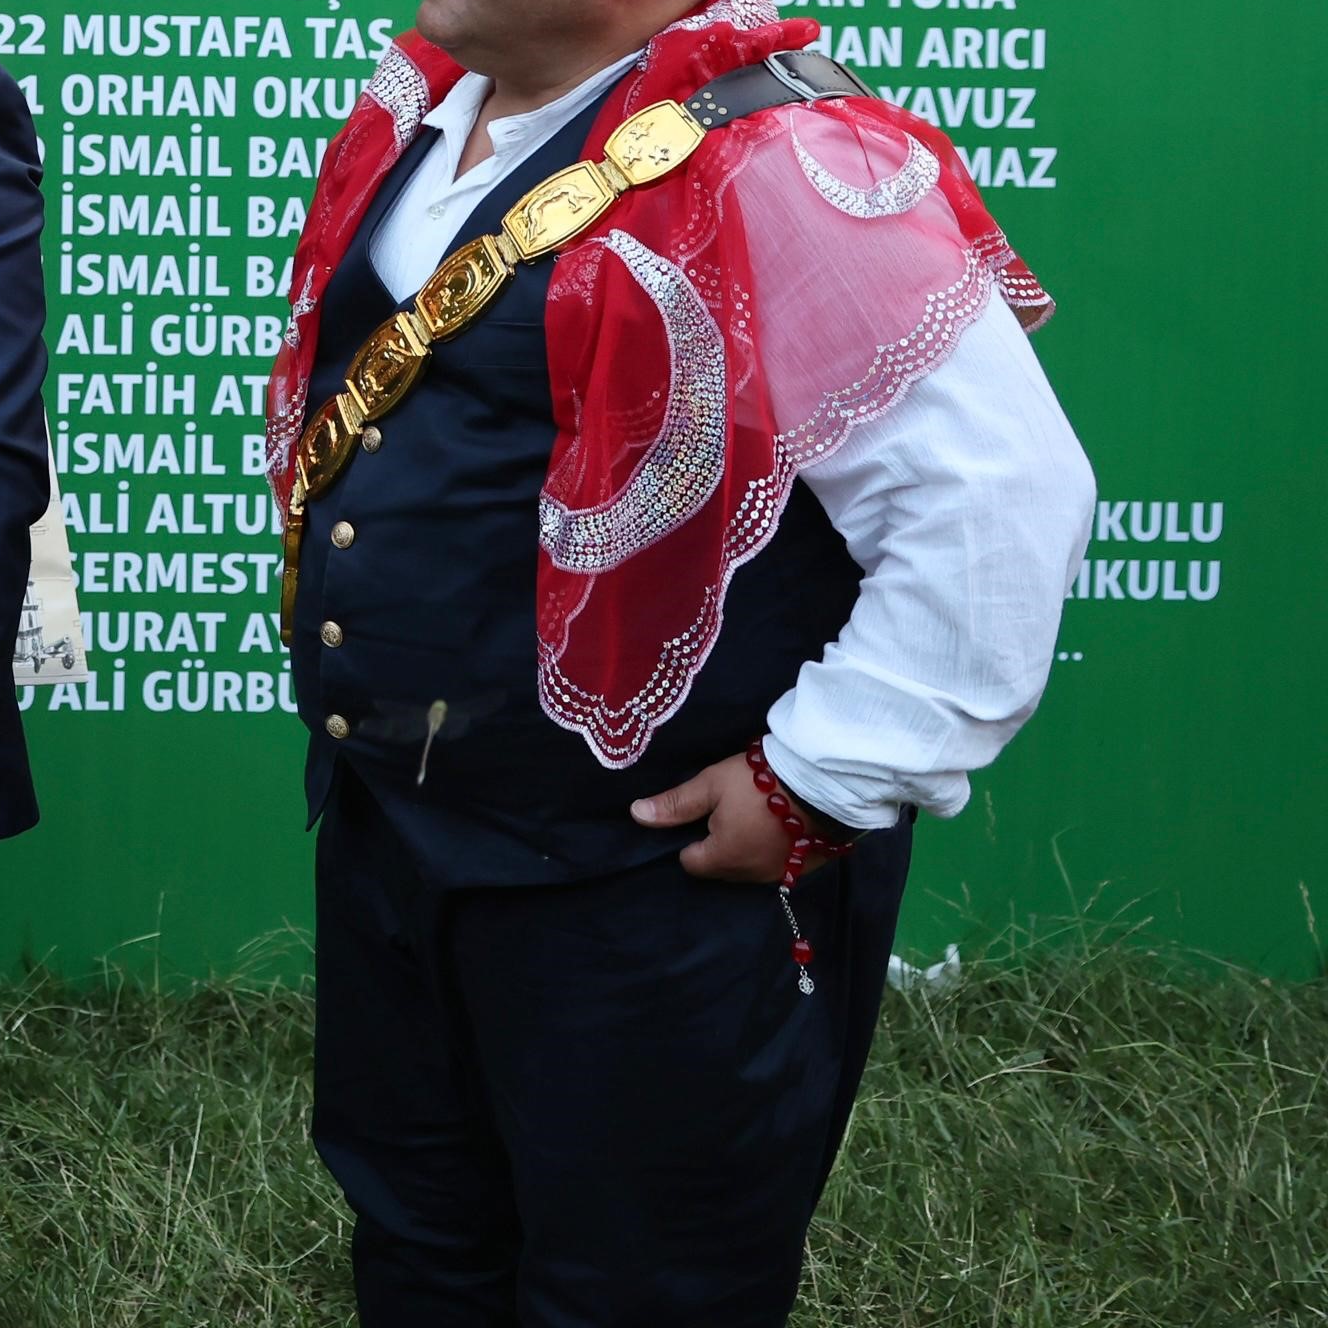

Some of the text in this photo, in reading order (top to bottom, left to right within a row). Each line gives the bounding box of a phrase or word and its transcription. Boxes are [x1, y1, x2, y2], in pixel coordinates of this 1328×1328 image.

[62, 13, 292, 58] MUSTAFA
[804, 25, 1046, 70] HAN ARICI
[60, 73, 236, 118] ORHAN
[253, 76, 368, 119] OKU
[62, 122, 232, 178] İSMAİL
[958, 146, 1058, 188] MAZ
[61, 181, 231, 237] İSMAİL
[60, 241, 230, 297] İSMAİL
[55, 301, 286, 357] ALİ GÜRB
[57, 361, 194, 415] FATİH
[57, 420, 226, 475] İSMAİL
[60, 480, 284, 535] ALİ ALTU
[1090, 501, 1224, 543] KULU
